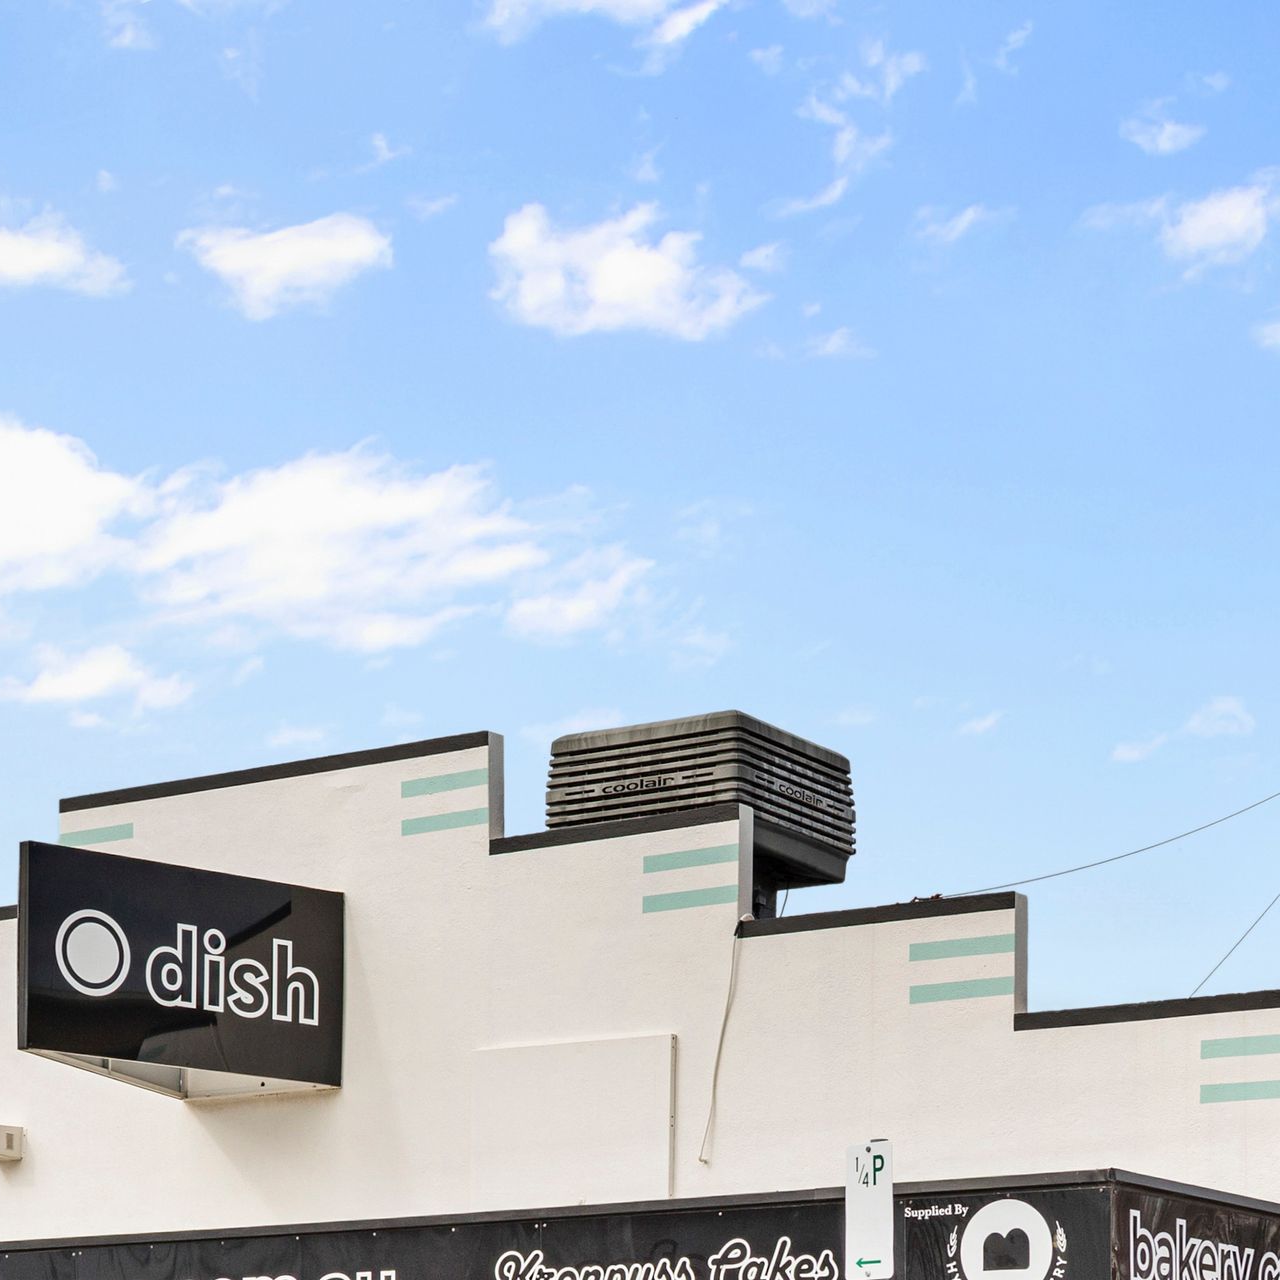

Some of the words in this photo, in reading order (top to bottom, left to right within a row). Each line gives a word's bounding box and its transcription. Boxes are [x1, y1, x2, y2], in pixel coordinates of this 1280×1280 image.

[602, 776, 675, 794] coolair
[778, 784, 823, 807] coolair
[145, 922, 320, 1026] dish
[904, 1205, 952, 1220] Supplied
[954, 1203, 969, 1218] By
